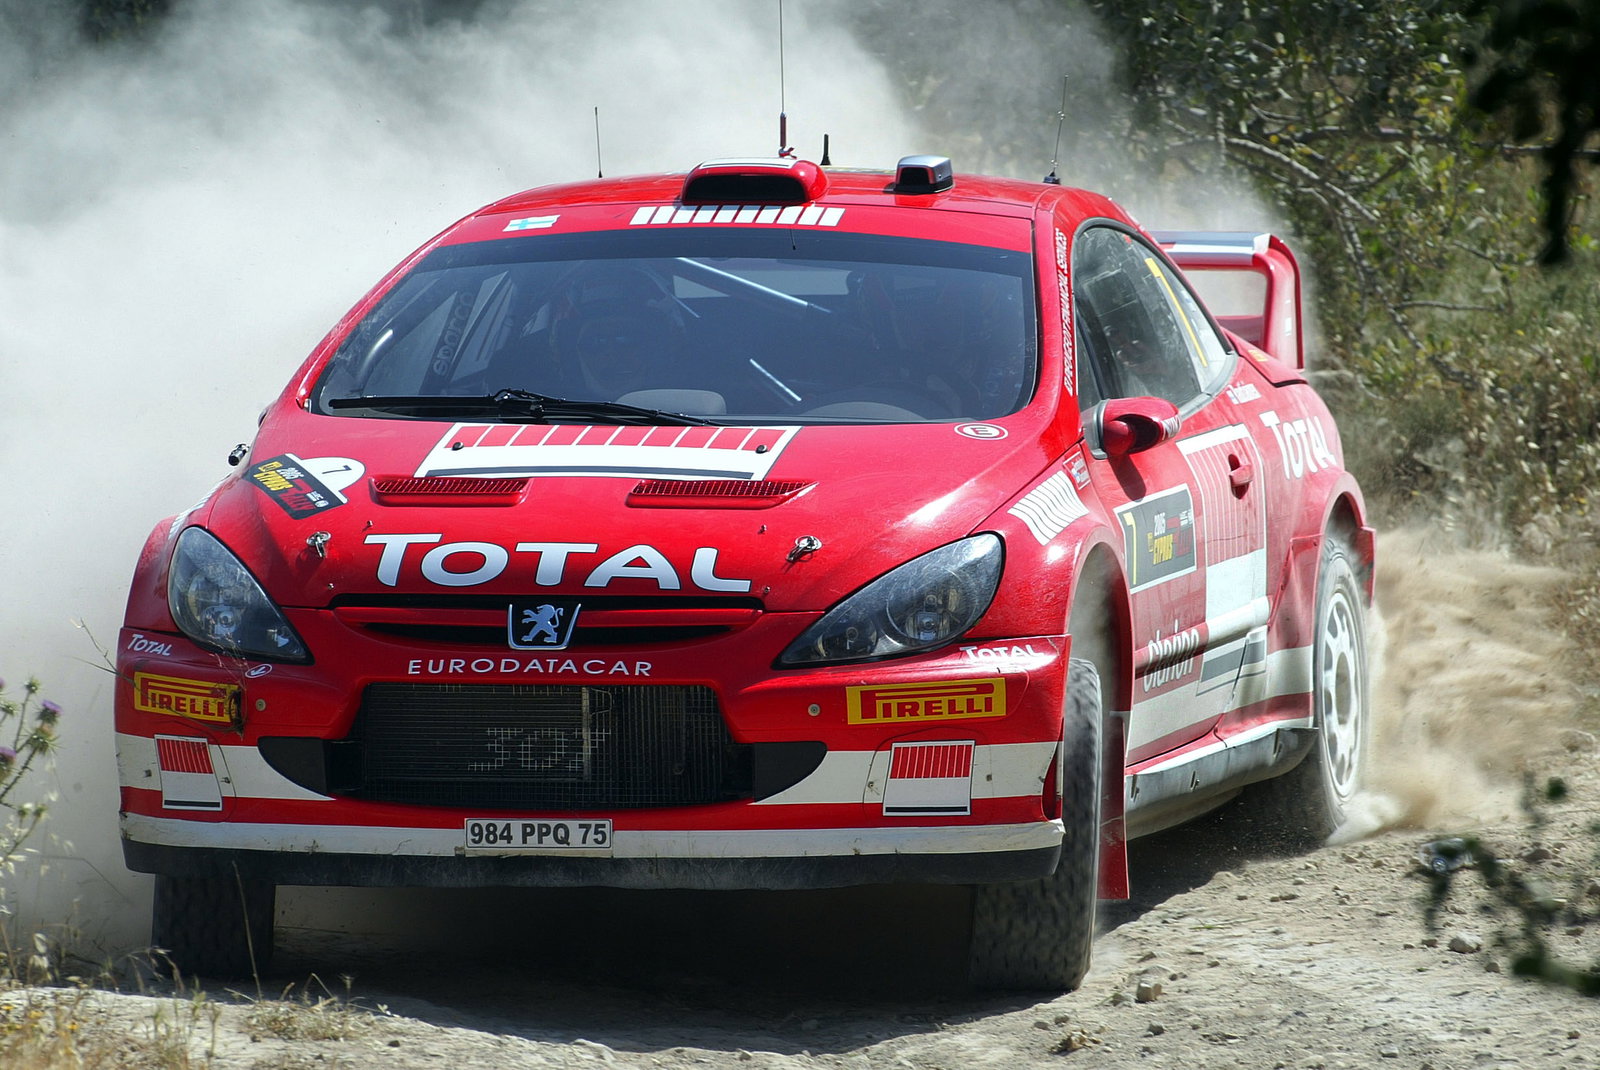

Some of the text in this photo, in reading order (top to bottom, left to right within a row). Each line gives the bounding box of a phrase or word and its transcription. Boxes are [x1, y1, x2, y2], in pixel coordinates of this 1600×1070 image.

[433, 291, 477, 377] sparco
[1259, 410, 1337, 479] TOTAL
[321, 465, 352, 475] 7
[363, 533, 753, 593] TOTAL
[1123, 512, 1136, 585] 7
[127, 634, 172, 656] TOTAL
[959, 644, 1045, 661] TOTAL
[407, 658, 653, 677] EURODATACAR
[140, 677, 227, 718] PIRELLI
[860, 683, 995, 720] PIRELLI
[470, 822, 607, 846] 984 PPQ 75
